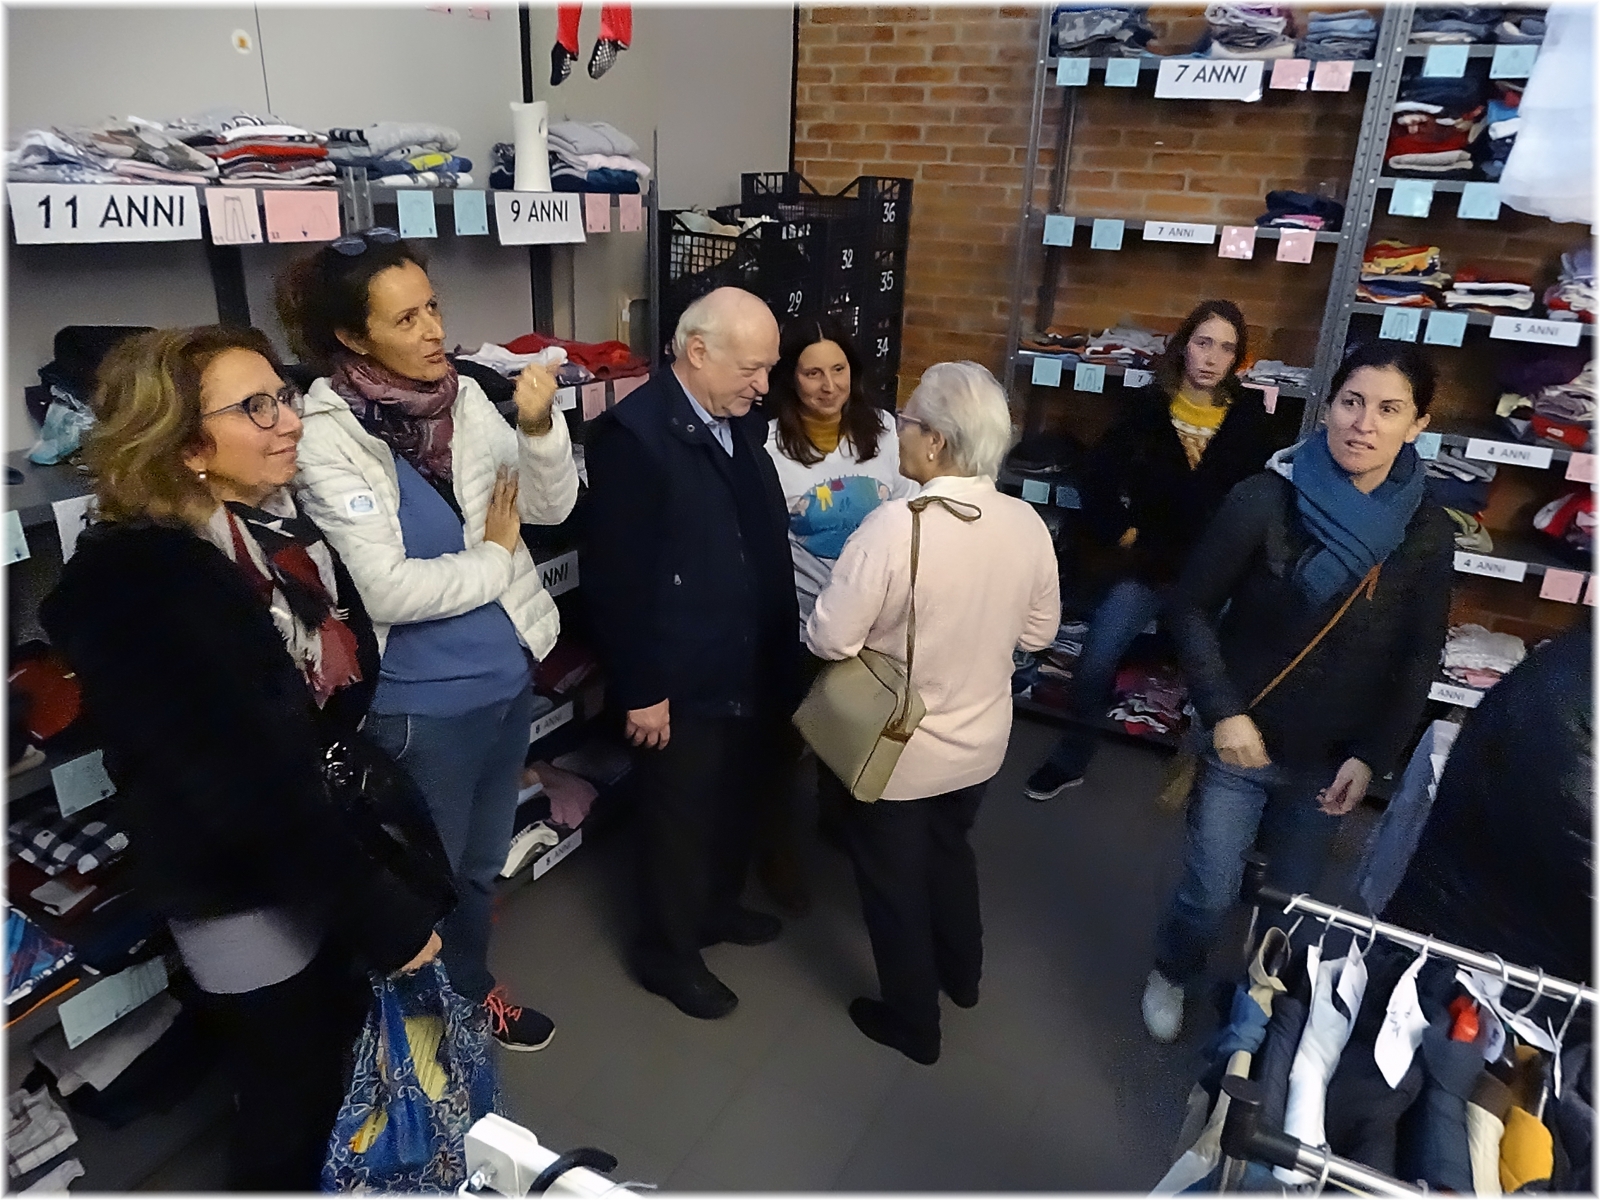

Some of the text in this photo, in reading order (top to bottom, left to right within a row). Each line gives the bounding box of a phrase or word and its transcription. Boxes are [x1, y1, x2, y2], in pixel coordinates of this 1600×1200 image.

[1174, 64, 1248, 84] 7 ANNI
[38, 194, 185, 229] 11 ANNI
[510, 199, 569, 223] 9 ANNI
[882, 202, 896, 223] 36
[1157, 226, 1195, 238] 7 ANNI
[841, 248, 854, 270] 32
[879, 270, 894, 292] 35
[787, 290, 803, 313] 29
[1513, 323, 1560, 337] 5 ANNI
[875, 336, 889, 358] 34
[1487, 446, 1532, 460] 4 ANNI
[1463, 558, 1507, 574] 4 ANNI
